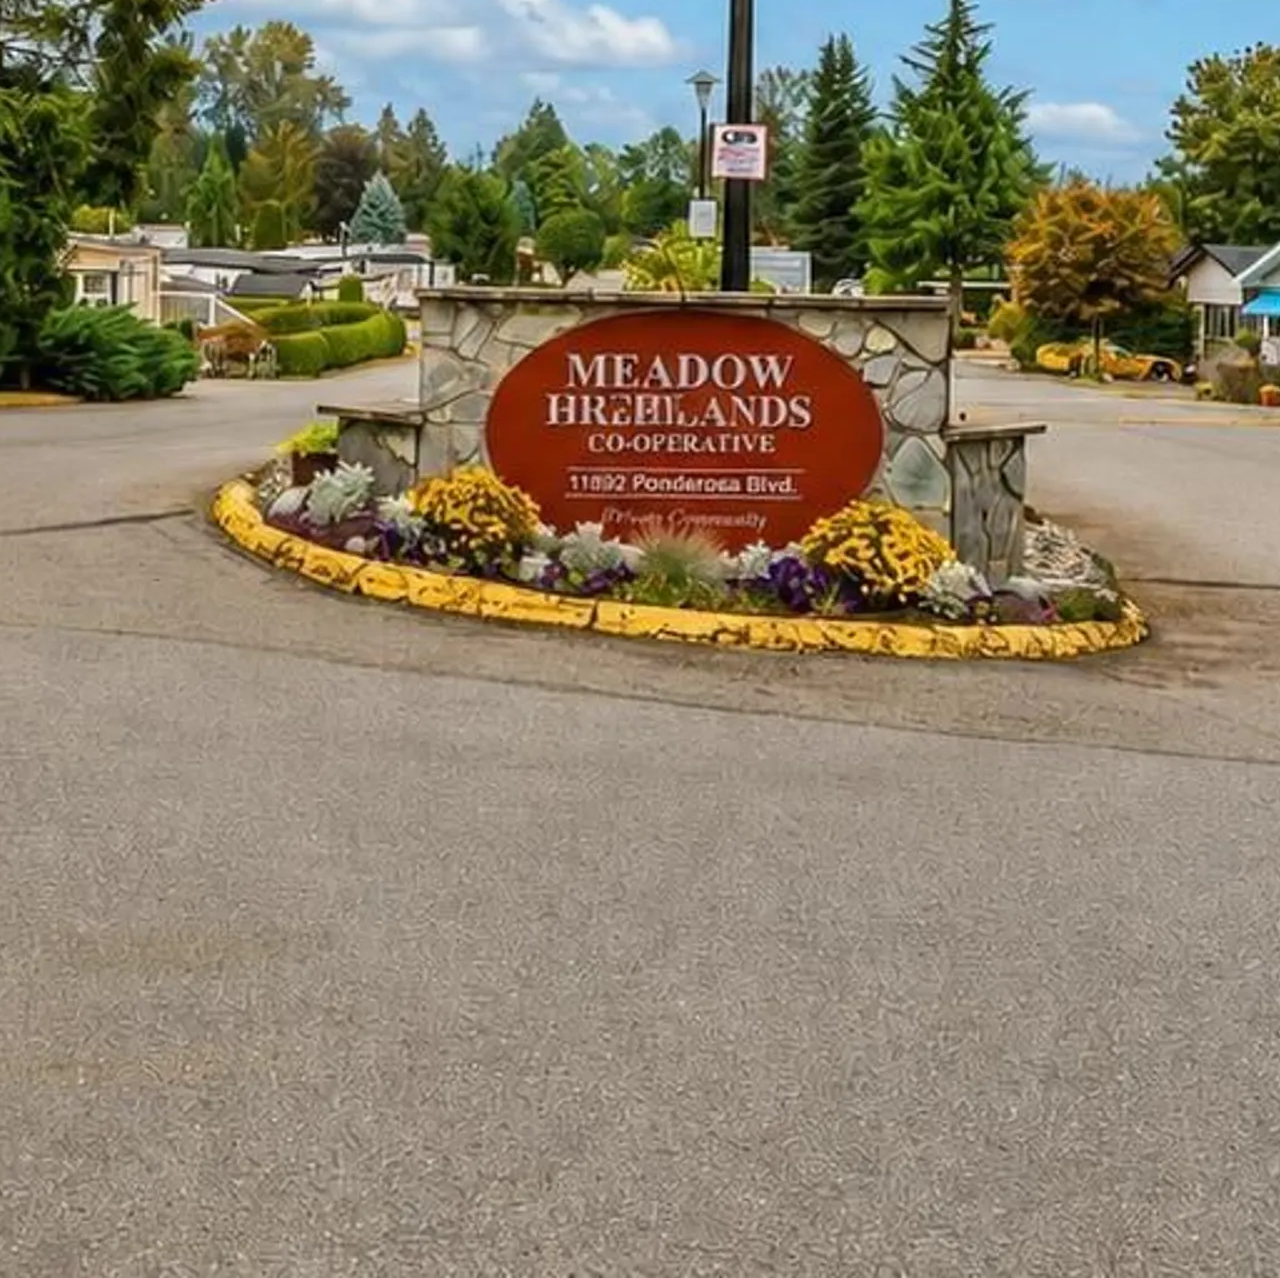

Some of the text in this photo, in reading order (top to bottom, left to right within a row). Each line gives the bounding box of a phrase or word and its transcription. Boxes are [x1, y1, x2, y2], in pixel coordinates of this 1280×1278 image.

[566, 353, 793, 389] MEADOW
[588, 433, 776, 453] CO-OPERATIVE
[746, 475, 798, 493] Blvd.
